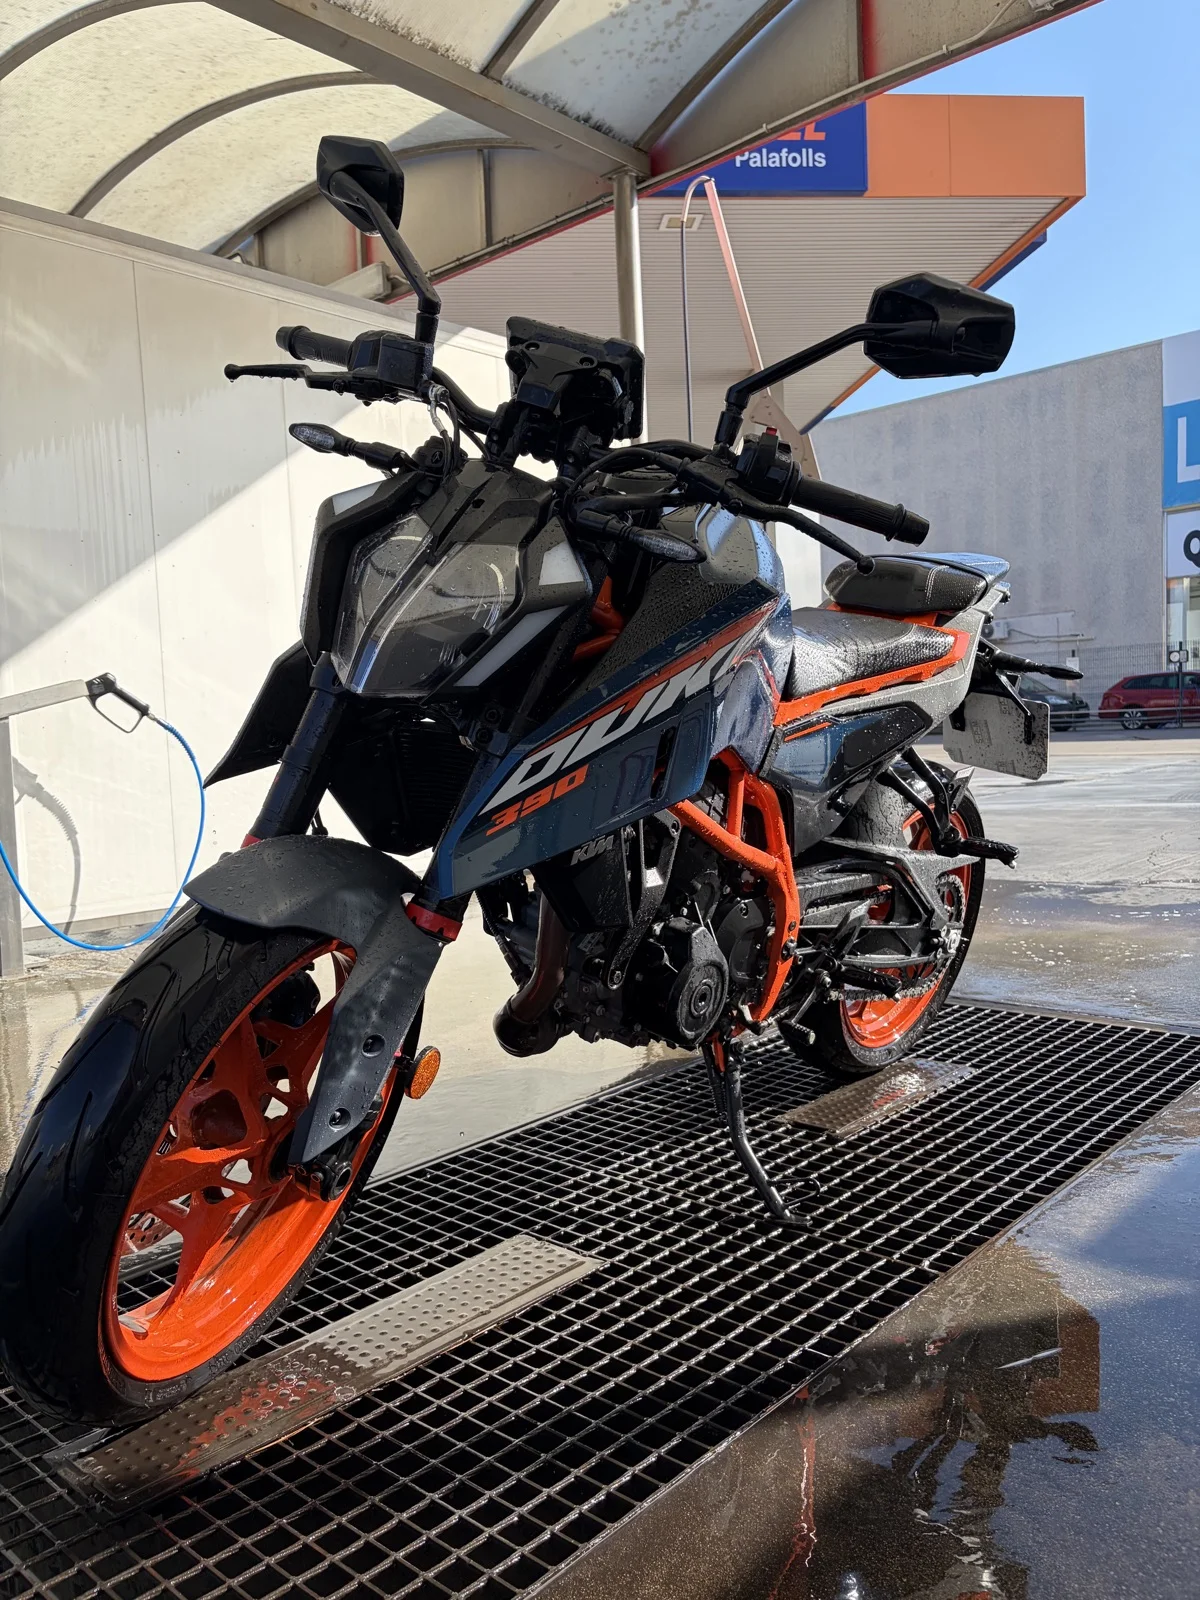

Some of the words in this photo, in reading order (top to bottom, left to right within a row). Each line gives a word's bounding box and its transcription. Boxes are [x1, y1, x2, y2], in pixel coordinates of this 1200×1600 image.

[735, 148, 826, 168] Palafolls
[486, 763, 589, 836] 390
[570, 835, 615, 866] KTM
